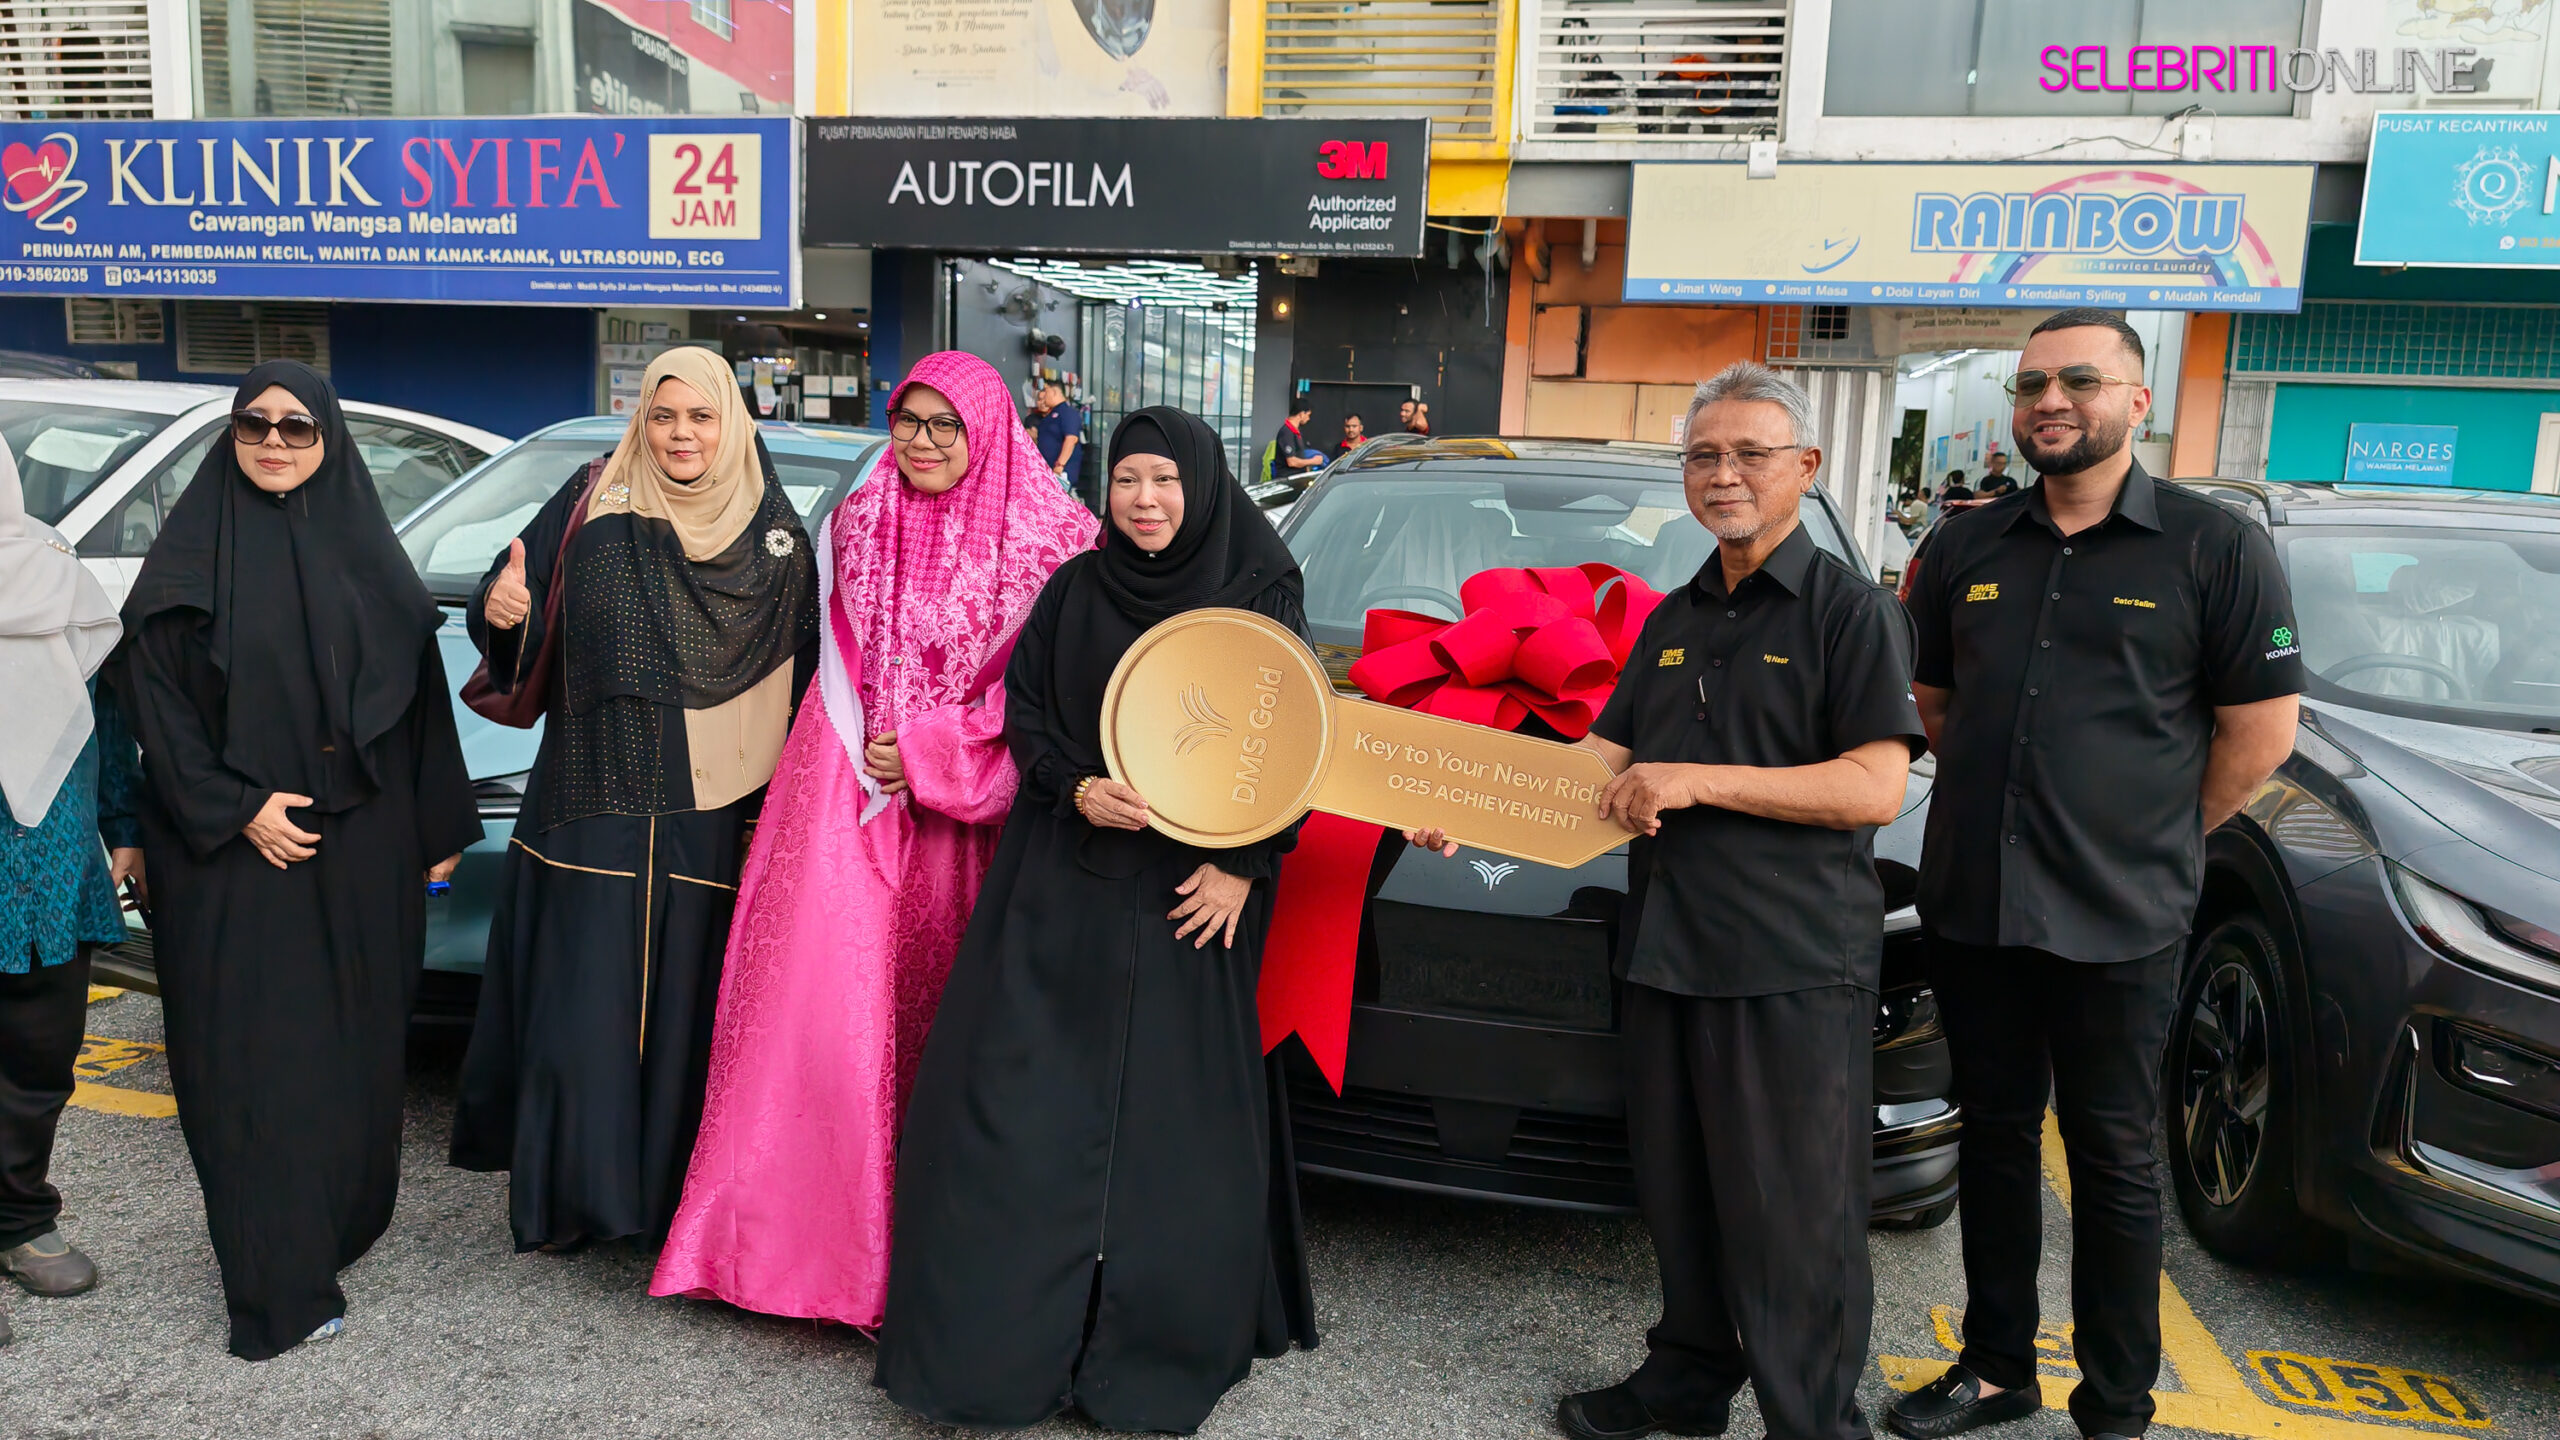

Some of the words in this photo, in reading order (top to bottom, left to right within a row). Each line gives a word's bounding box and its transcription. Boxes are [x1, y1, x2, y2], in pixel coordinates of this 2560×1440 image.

[818, 125, 849, 140] PUSAT
[850, 125, 916, 140] PEMASANGAN
[917, 125, 946, 140] FILEM
[947, 126, 989, 140] PENAPIS
[989, 126, 1018, 140] HABA
[2379, 119, 2433, 132] PUSAT
[2438, 120, 2548, 132] KECANTIKAN
[1317, 140, 1388, 179] 3M
[104, 138, 382, 206] KLINIK
[673, 143, 739, 194] 24
[888, 160, 1134, 207] AUTOFILM
[1308, 195, 1396, 211] Authorized
[672, 200, 736, 226] JAM
[189, 211, 304, 237] Cawangan
[311, 211, 400, 238] Wangsa
[409, 212, 517, 235] Melawati
[1309, 213, 1392, 233] Applicator
[1911, 192, 2245, 256] RAINBOW
[23, 243, 113, 258] PERUBATAN
[119, 244, 146, 261] AM,
[152, 244, 256, 260] PEMBEDAHAN
[262, 246, 314, 263] KECIL,
[319, 247, 380, 261] WANITA
[386, 248, 420, 262] DAN
[425, 248, 554, 266] KANAK-KANAK,
[560, 250, 682, 267] ULTRASOUND,
[688, 250, 724, 265] ECG
[2154, 261, 2211, 273] Laundry
[123, 268, 216, 284] 03-41313035
[1674, 283, 1704, 295] Jimat
[1709, 283, 1742, 297] Wang
[1780, 284, 1811, 296] Jimat
[1816, 285, 1848, 296] Masa
[1886, 286, 1913, 298] Dobi
[1918, 286, 1954, 299] Layan
[1959, 287, 1980, 299] Diri
[2021, 288, 2082, 300] Kendalian
[2086, 289, 2126, 303] Syiling
[2164, 290, 2207, 302] Mudah
[2213, 290, 2261, 303] Kendali
[2353, 441, 2453, 460] NARQES
[2366, 462, 2402, 471] WANGSA
[2404, 462, 2447, 472] MELAWATI
[1966, 591, 1999, 602] GOLD
[1970, 583, 1998, 593] DMS
[1662, 648, 1685, 657] DMS
[1658, 656, 1685, 667] GOLD
[1249, 665, 1285, 730] Gold
[1231, 734, 1268, 805] DMS
[1353, 730, 1401, 761] Key
[1404, 743, 1429, 765] to
[1433, 748, 1490, 779] Your
[1493, 761, 1550, 793] New
[1435, 784, 1583, 831] ACHIEVEMENT
[2259, 1355, 2488, 1422] 050
